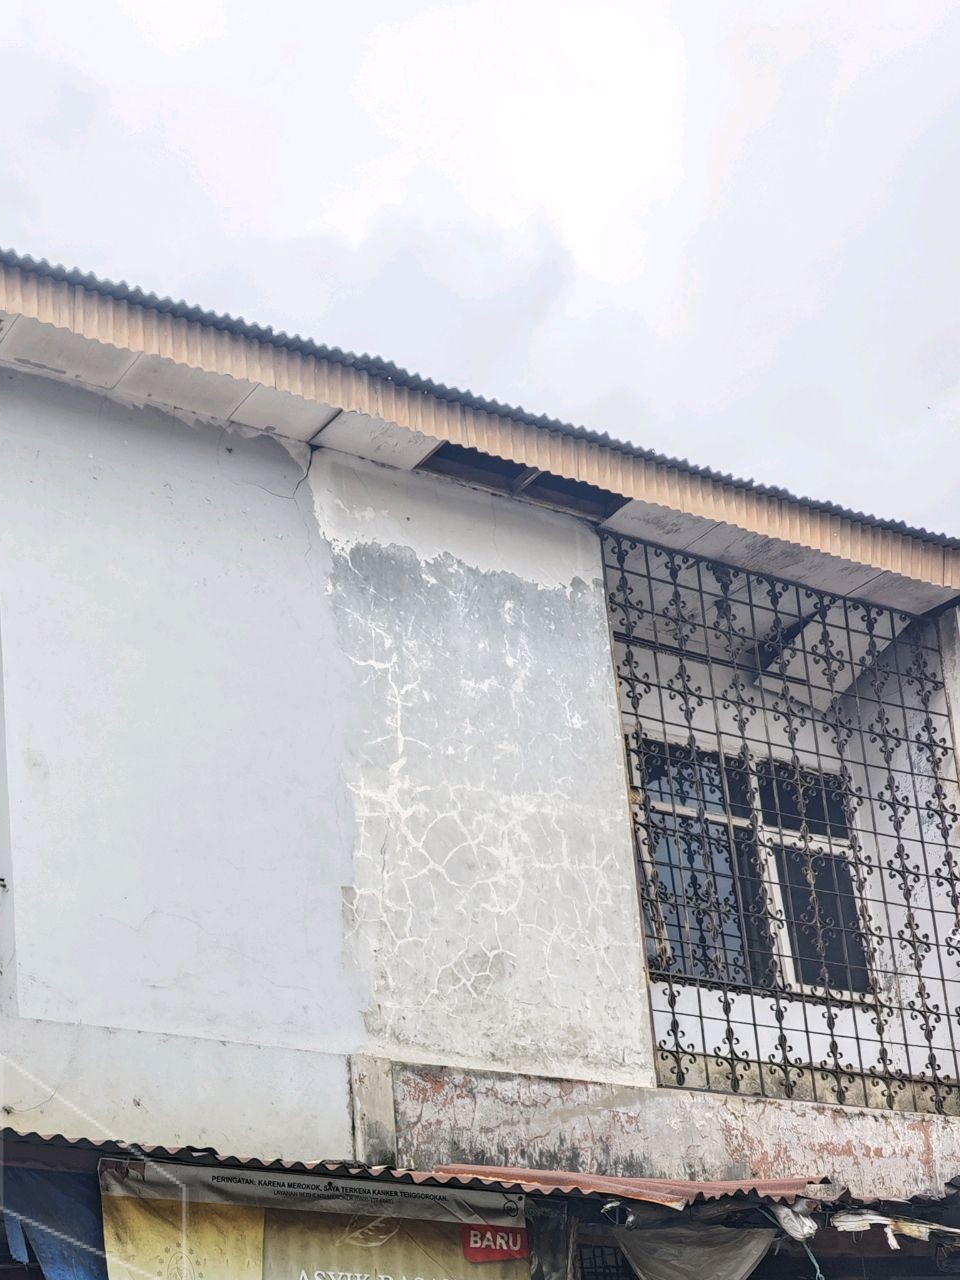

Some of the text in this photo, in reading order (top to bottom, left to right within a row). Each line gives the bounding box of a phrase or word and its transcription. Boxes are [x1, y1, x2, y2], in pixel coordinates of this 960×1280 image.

[258, 1180, 285, 1188] KARENA
[287, 1182, 322, 1192] MEROKOK,
[323, 1184, 340, 1192] SAYA
[342, 1186, 372, 1195] TERKENA
[372, 1188, 398, 1197] KANKER
[469, 1230, 521, 1251] BARU
